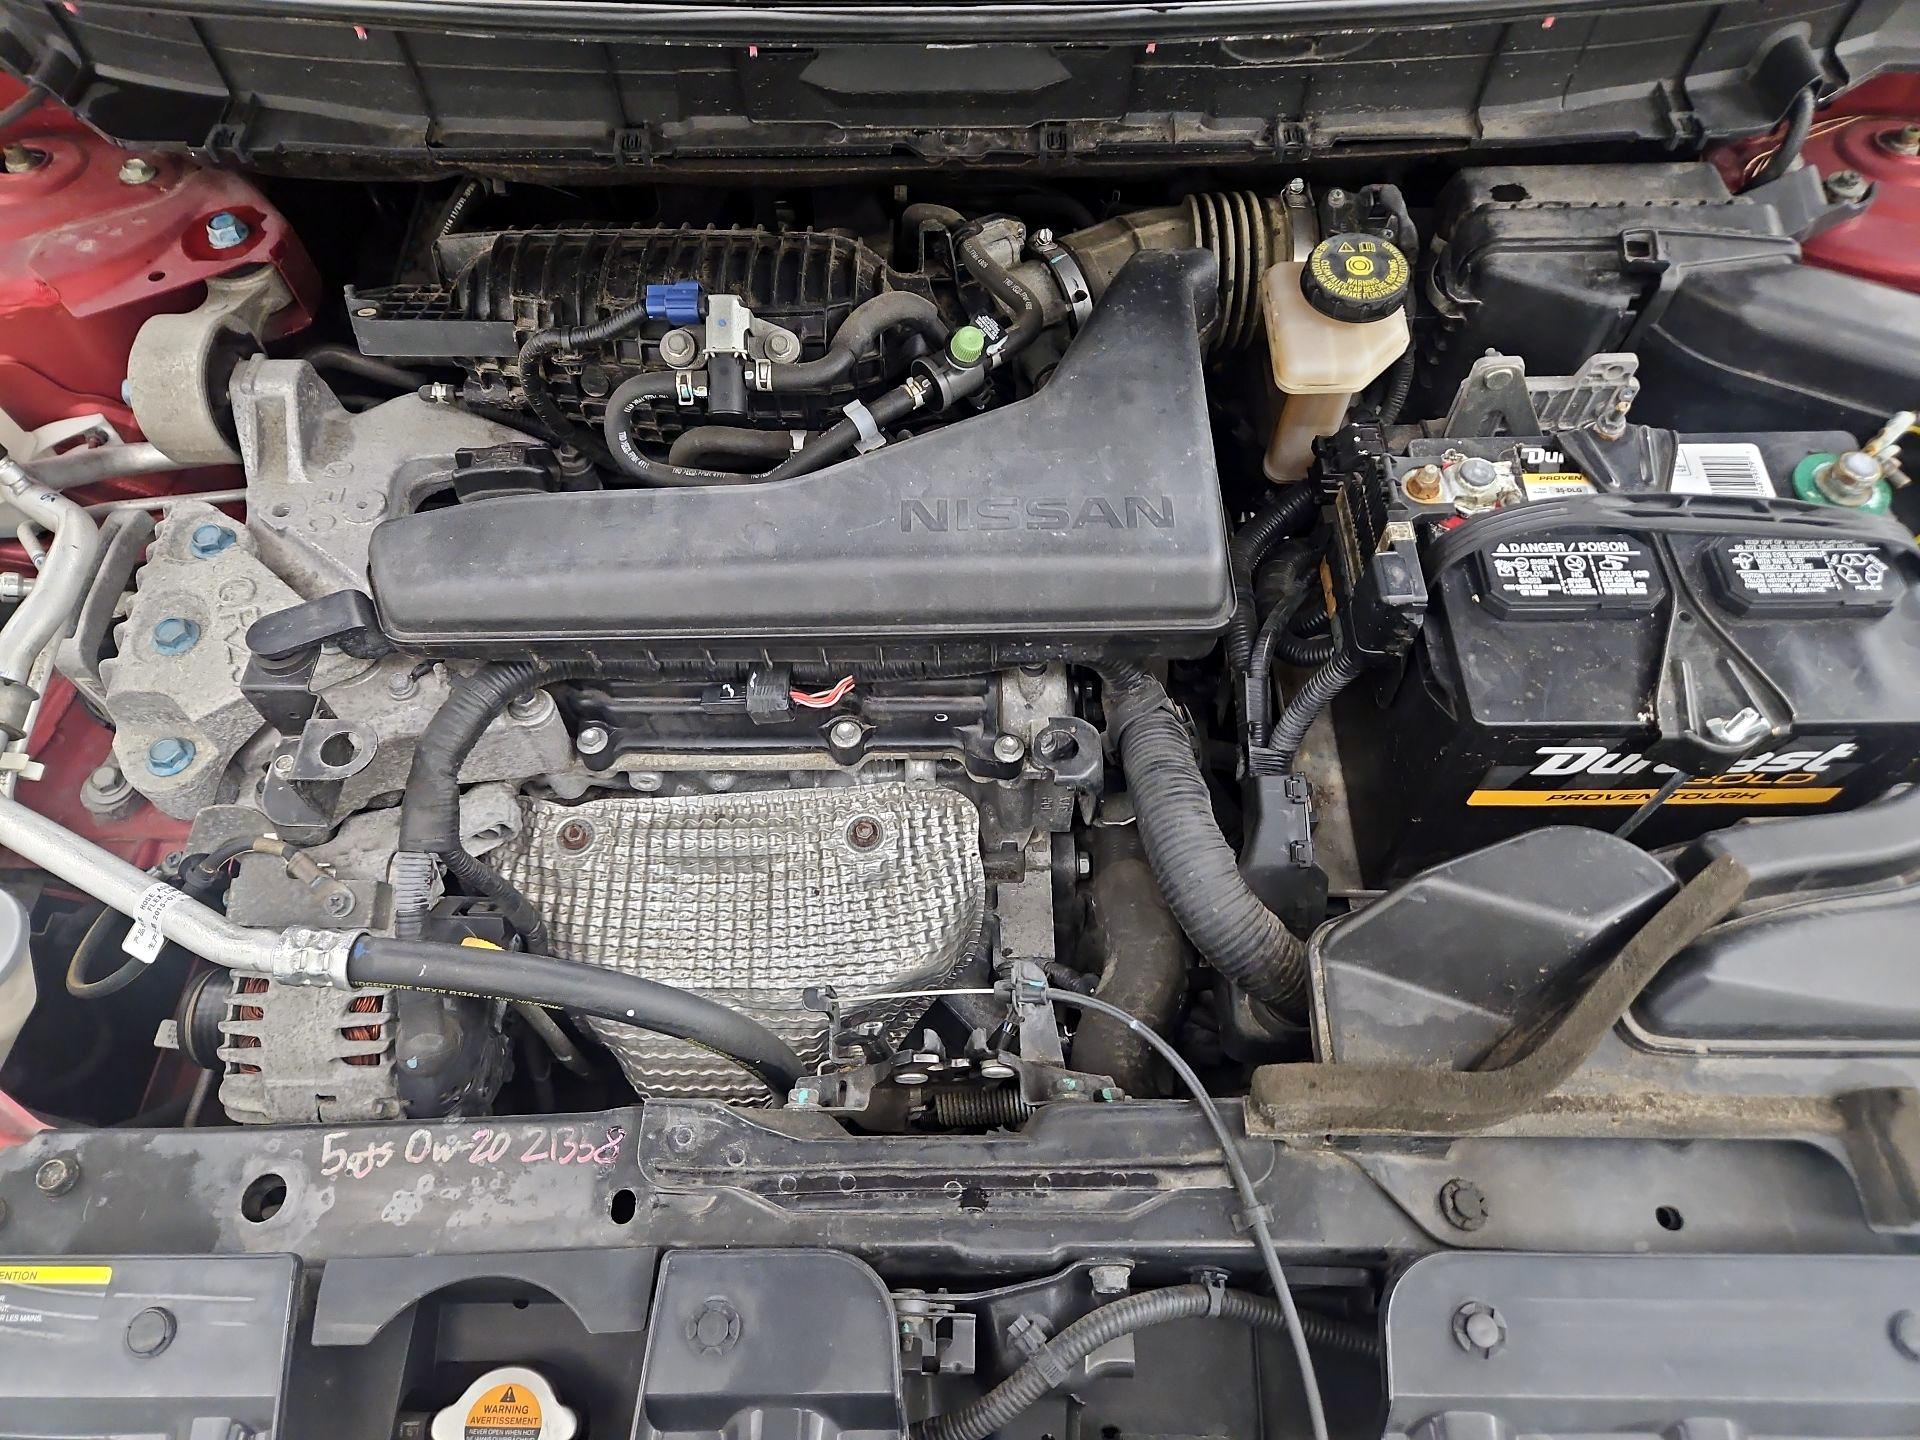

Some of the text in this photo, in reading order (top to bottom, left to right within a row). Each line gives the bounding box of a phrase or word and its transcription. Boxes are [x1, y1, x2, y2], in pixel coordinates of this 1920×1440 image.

[900, 496, 1175, 532] NISSAN
[1509, 542, 1565, 552] DANGER
[1578, 542, 1629, 552] POISON
[1546, 793, 1654, 801] PROVEN
[140, 892, 155, 910] HOSE
[484, 1404, 529, 1414] WARNING
[470, 1416, 539, 1426] AVERTISSEMENT
